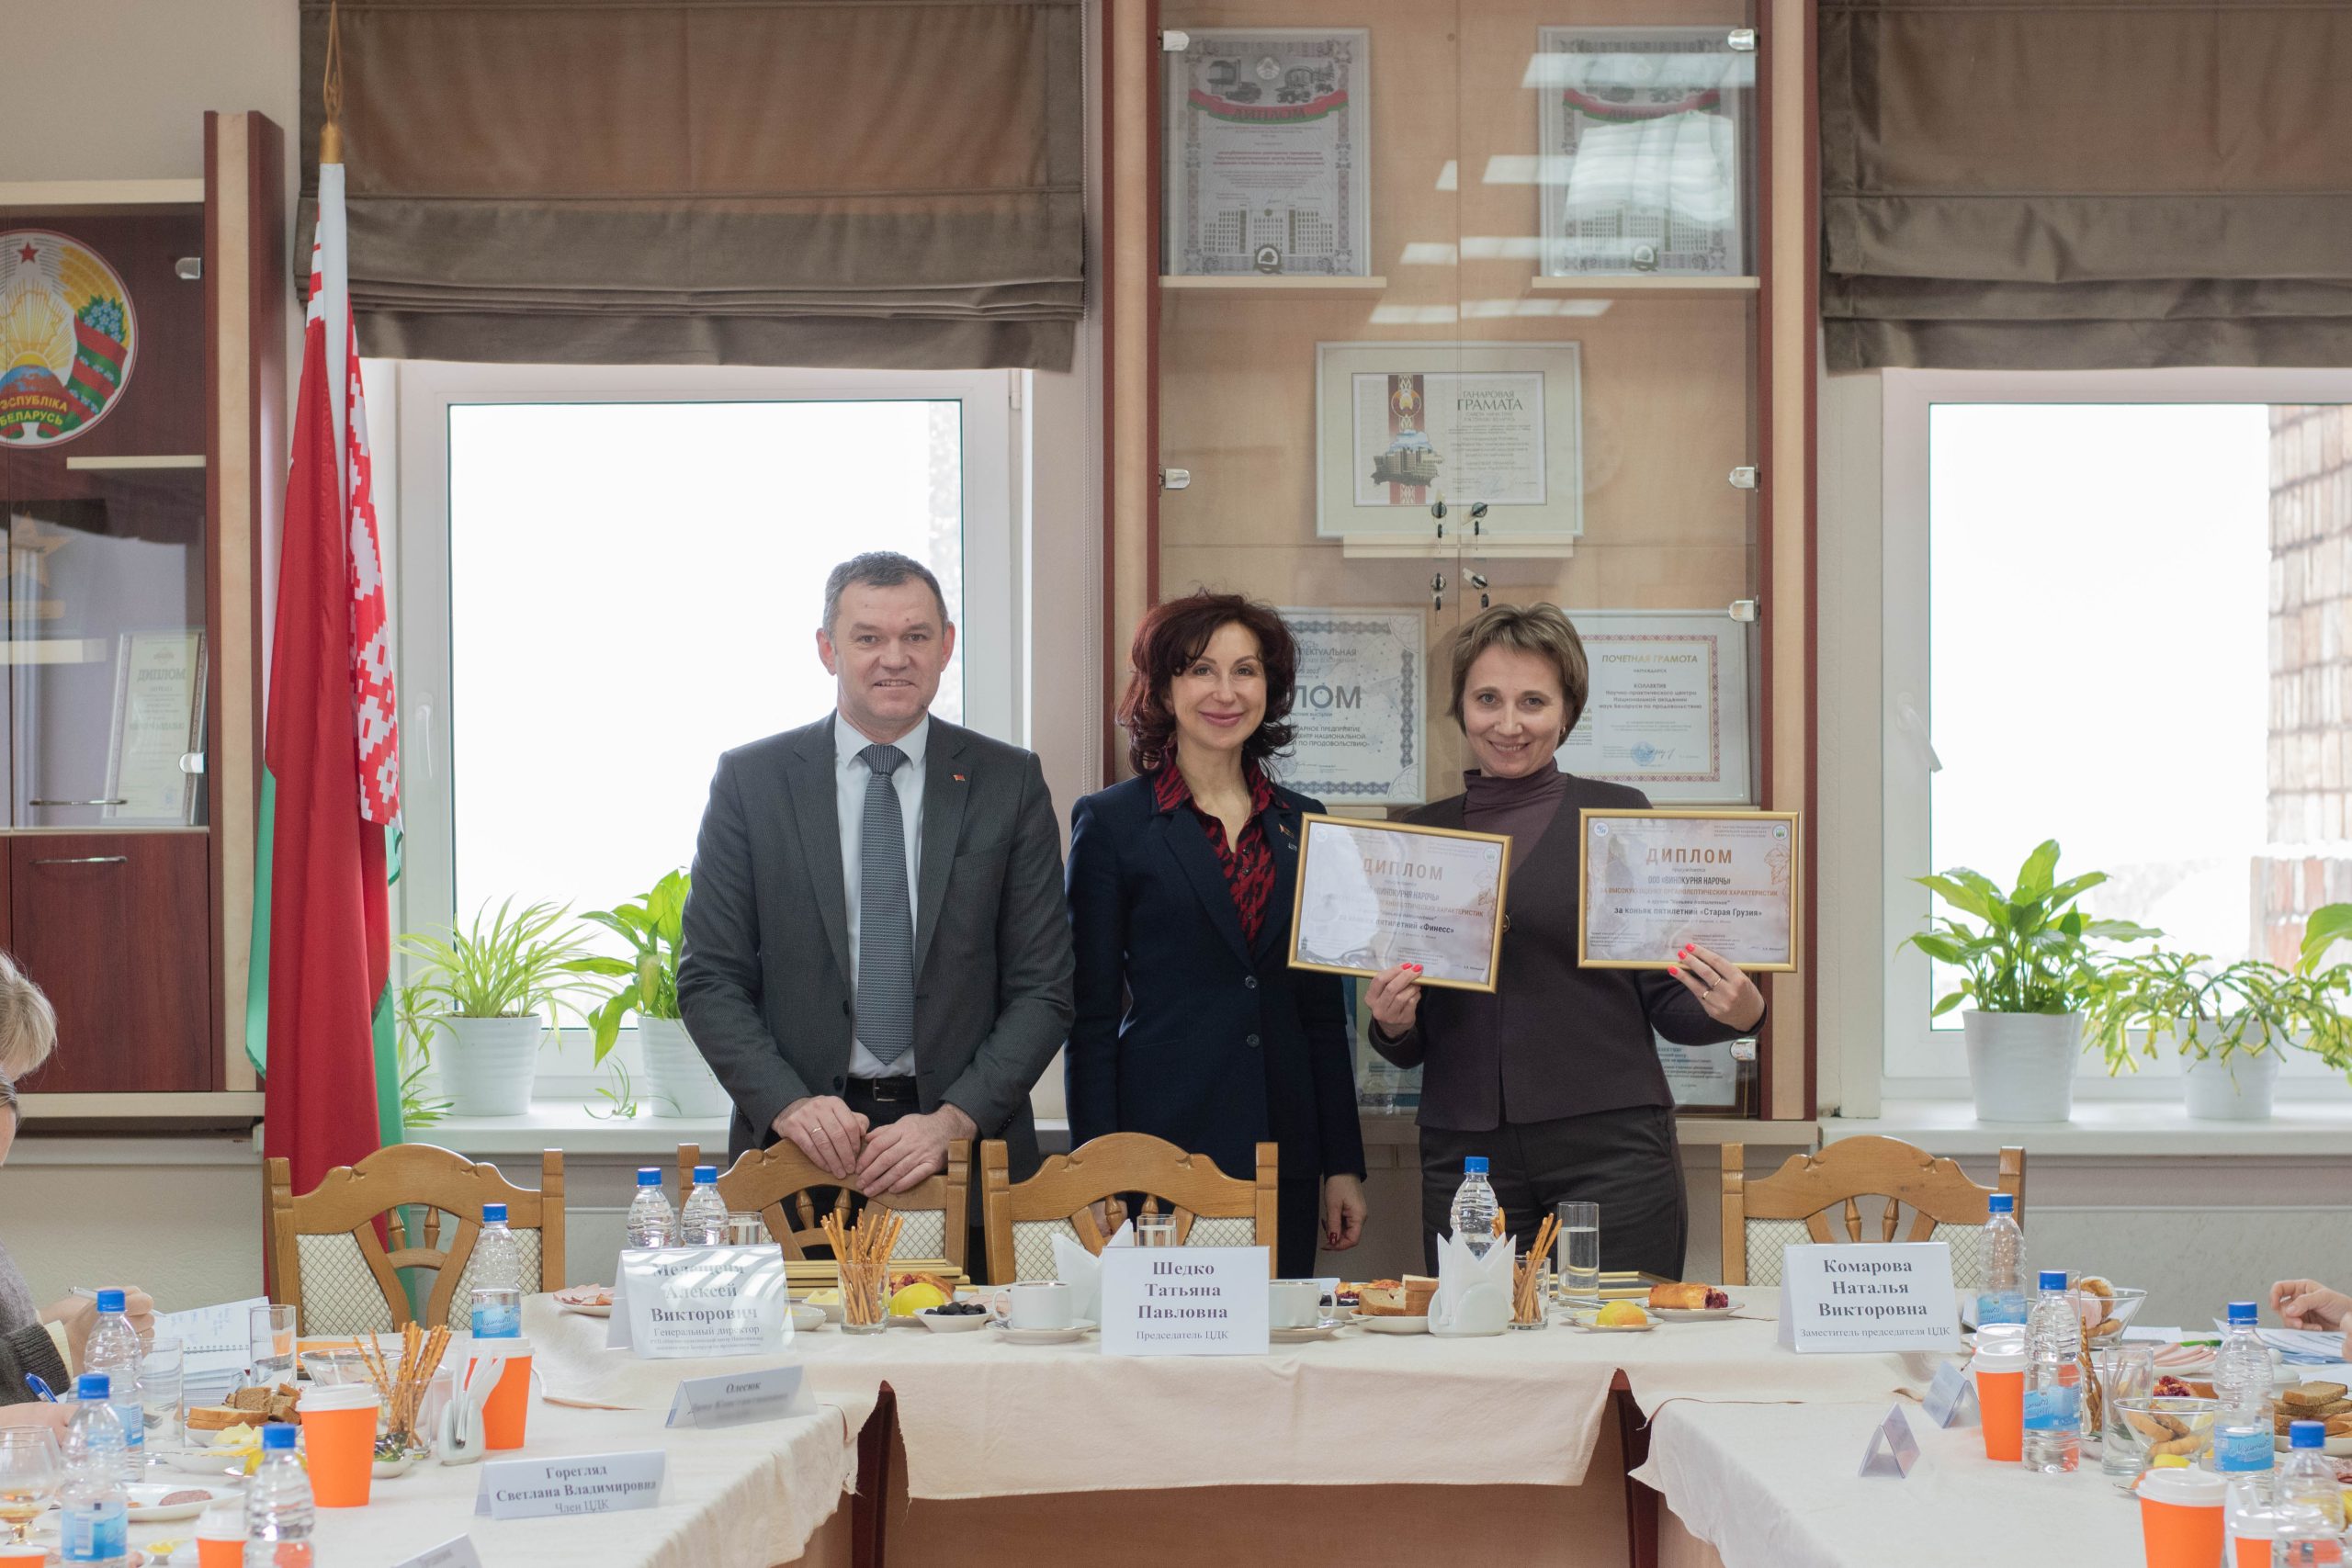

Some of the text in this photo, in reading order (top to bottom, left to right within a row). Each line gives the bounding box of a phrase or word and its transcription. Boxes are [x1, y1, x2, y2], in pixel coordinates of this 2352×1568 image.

[1464, 390, 1515, 399] ГАНАРОВАЯ
[0, 394, 68, 413] ЭСПУБЛІКА
[1457, 399, 1523, 411] ГРАМАТА
[0, 410, 64, 427] БЕЛАРУСЬ
[1601, 654, 1698, 663] ПОЧЕТНАЯ ГРАМОТА
[137, 667, 187, 682] ДИПЛОМ
[1294, 684, 1361, 709] ЛОМ
[1645, 847, 1733, 865] ДИПЛОМ
[1363, 857, 1443, 881] ДИПЛОМ
[1729, 889, 1778, 897] ХАРАКТЕРИСТИК
[1700, 908, 1731, 918] «Старая
[1732, 908, 1762, 919] Грузия»
[1419, 922, 1454, 934] «Финесс»
[1153, 1261, 1215, 1276] Шедко
[1823, 1259, 1913, 1276] Комарова
[664, 1282, 738, 1300] Алексей
[1145, 1283, 1221, 1297] Татьяна
[1832, 1280, 1909, 1294] Наталья
[650, 1306, 758, 1325] Викторович
[1137, 1305, 1228, 1319] Павловна
[1818, 1302, 1928, 1320] Викторовна
[653, 1325, 760, 1339] Генеральный директор
[1136, 1330, 1228, 1341] Председатель ЦДК
[1801, 1326, 1951, 1338] Заместитель председателя ЦДК
[725, 1381, 762, 1394] Олесюк
[546, 1464, 608, 1482] Горегляд
[495, 1478, 657, 1503] Светлана Владимировна
[555, 1498, 610, 1515] Член ЦДК
